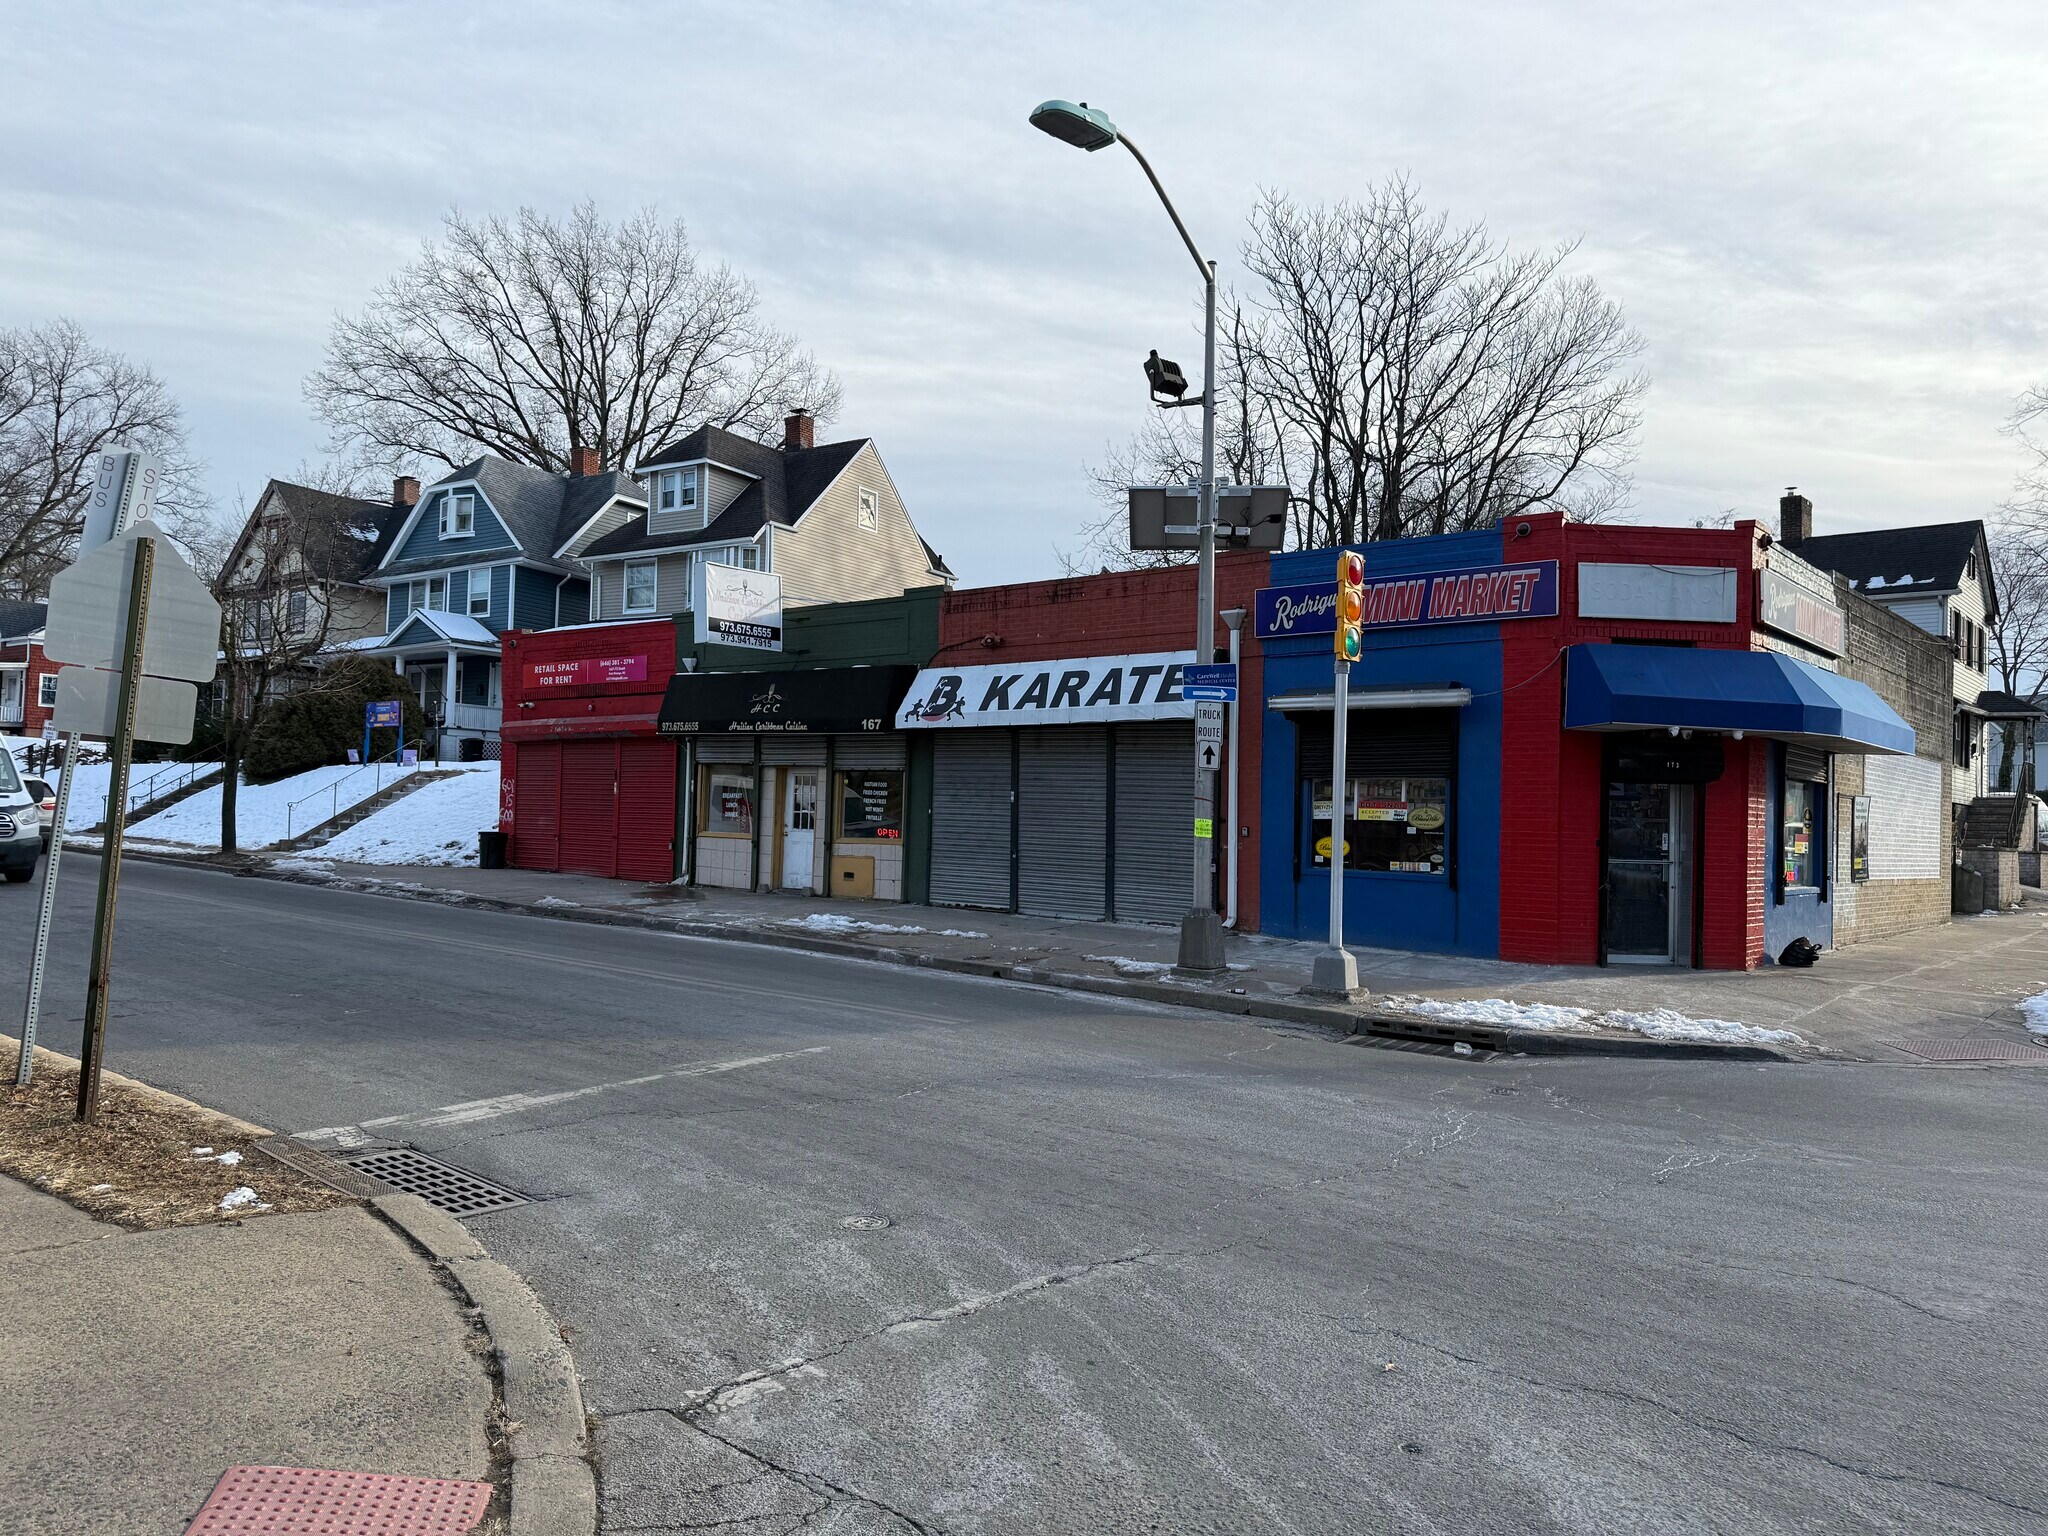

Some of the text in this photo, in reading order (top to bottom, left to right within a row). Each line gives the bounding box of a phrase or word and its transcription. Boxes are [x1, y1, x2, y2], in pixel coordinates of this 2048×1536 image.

[94, 456, 114, 508] BUS
[134, 468, 156, 526] STO
[1270, 568, 1541, 632] Rodrigu MINI MARKET
[720, 621, 772, 638] 973.675.6555
[720, 634, 772, 648] 973.941.7915
[534, 662, 578, 674] RETAIL SPACE
[540, 675, 572, 685] FOR RENT
[978, 664, 1184, 712] KARATE
[1198, 710, 1220, 720] TRUCK
[662, 721, 699, 732] 973.675.6555
[861, 718, 882, 730] 167
[1198, 726, 1220, 738] ROUTE
[877, 828, 899, 838] OPEN
